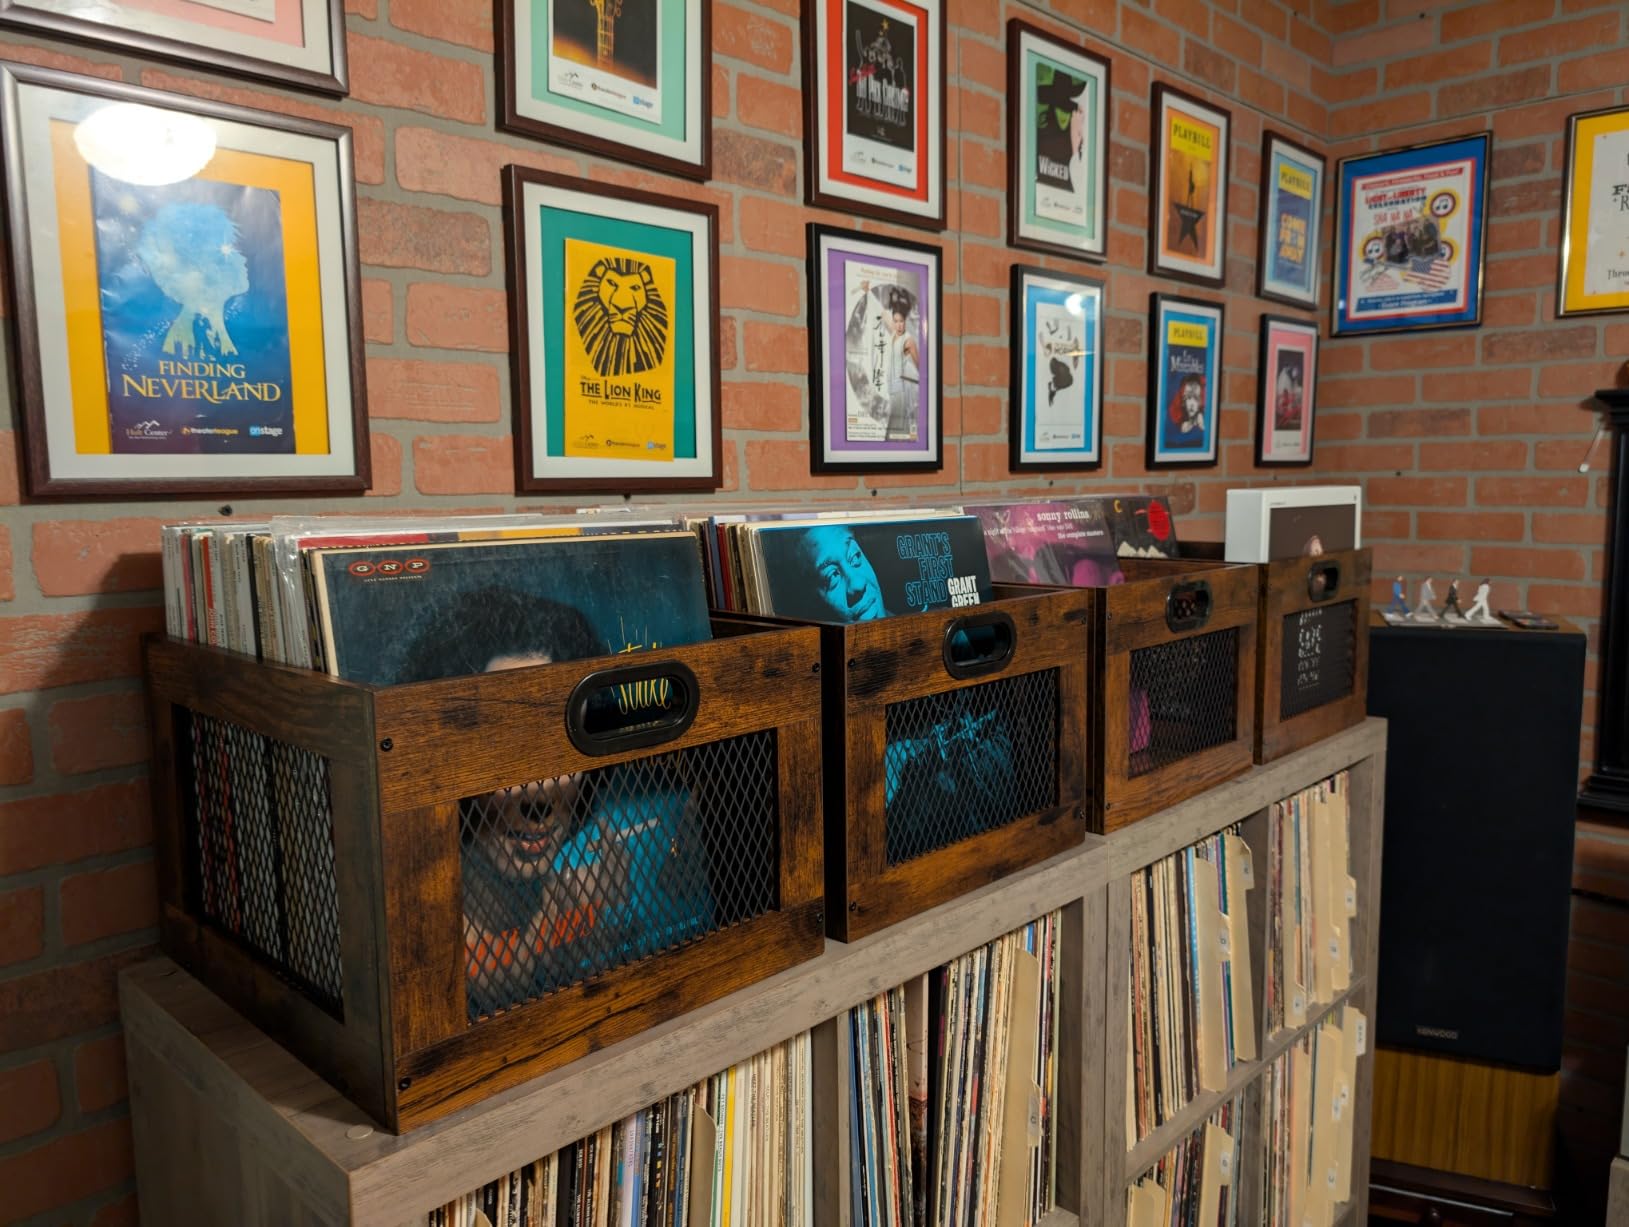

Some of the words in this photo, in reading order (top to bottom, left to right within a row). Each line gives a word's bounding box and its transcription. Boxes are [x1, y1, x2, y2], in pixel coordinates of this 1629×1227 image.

[1172, 123, 1211, 149] PLAYBILL
[1038, 155, 1070, 181] WICKED
[1279, 172, 1311, 193] PLAYBILL
[1173, 327, 1204, 341] PLAYBILL
[158, 359, 247, 379] FINDING
[121, 373, 282, 404] NEVERLAND
[580, 381, 602, 396] THE
[604, 380, 632, 400] LION
[634, 382, 662, 403] KING
[249, 425, 283, 437] onstage
[1036, 511, 1061, 523] sonny
[1064, 508, 1090, 520] rollins
[896, 532, 952, 560] GRANT'S
[918, 554, 954, 581] FIRST
[905, 579, 948, 607] STAND
[947, 575, 977, 596] GRANT
